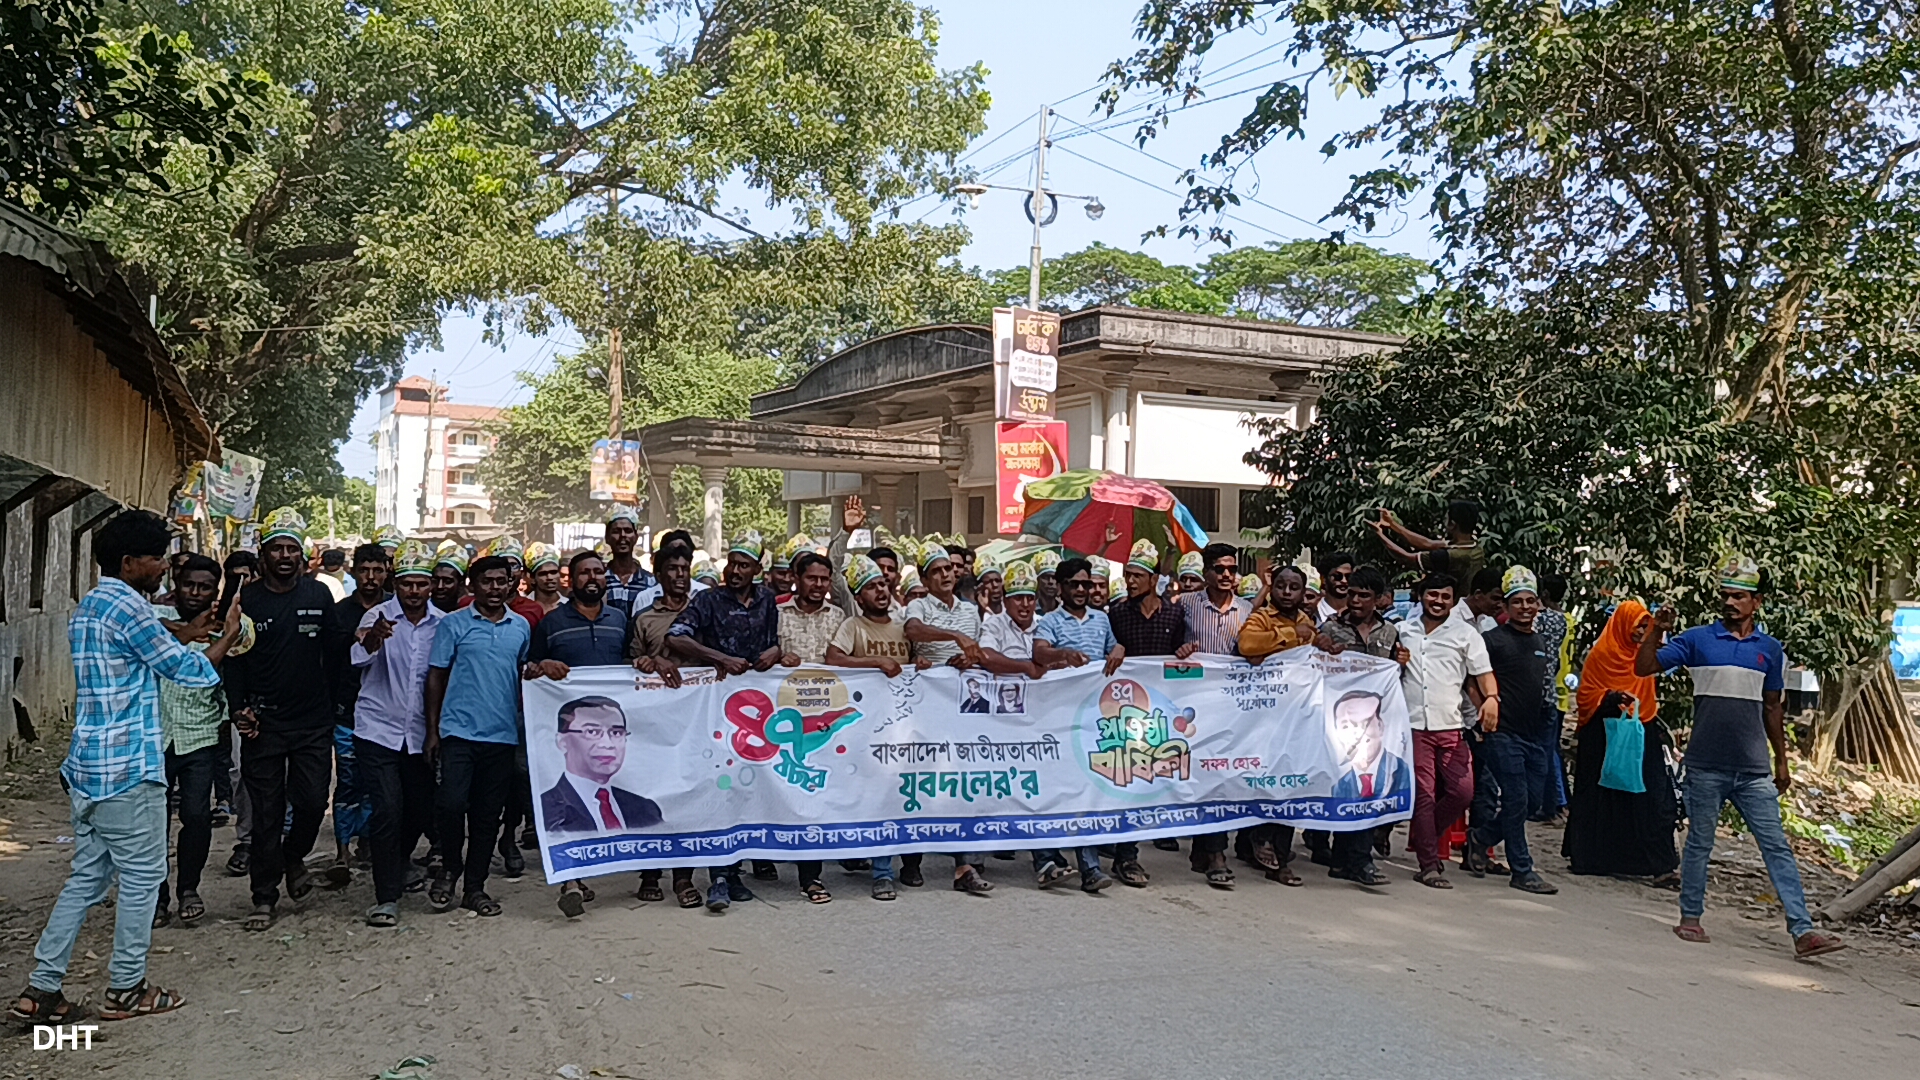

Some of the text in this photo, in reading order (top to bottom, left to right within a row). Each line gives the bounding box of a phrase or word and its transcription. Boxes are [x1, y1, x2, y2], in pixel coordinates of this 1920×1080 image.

[724, 688, 838, 765] ৪৭
[869, 734, 1061, 765] বাংলাদেশ জাতীয়তাবাদী
[564, 839, 673, 861] আয়োজনেঃ
[678, 828, 768, 851] বাংলাদেশ
[773, 821, 901, 845] জাতীয়তাবাদী
[904, 823, 967, 841] যুবদল,
[973, 820, 1010, 836] ৫নং
[1016, 814, 1122, 835] বাকলজোড়া
[1124, 805, 1199, 828] ইউনিয়ন
[1259, 800, 1330, 818] দুর্গাপুর,
